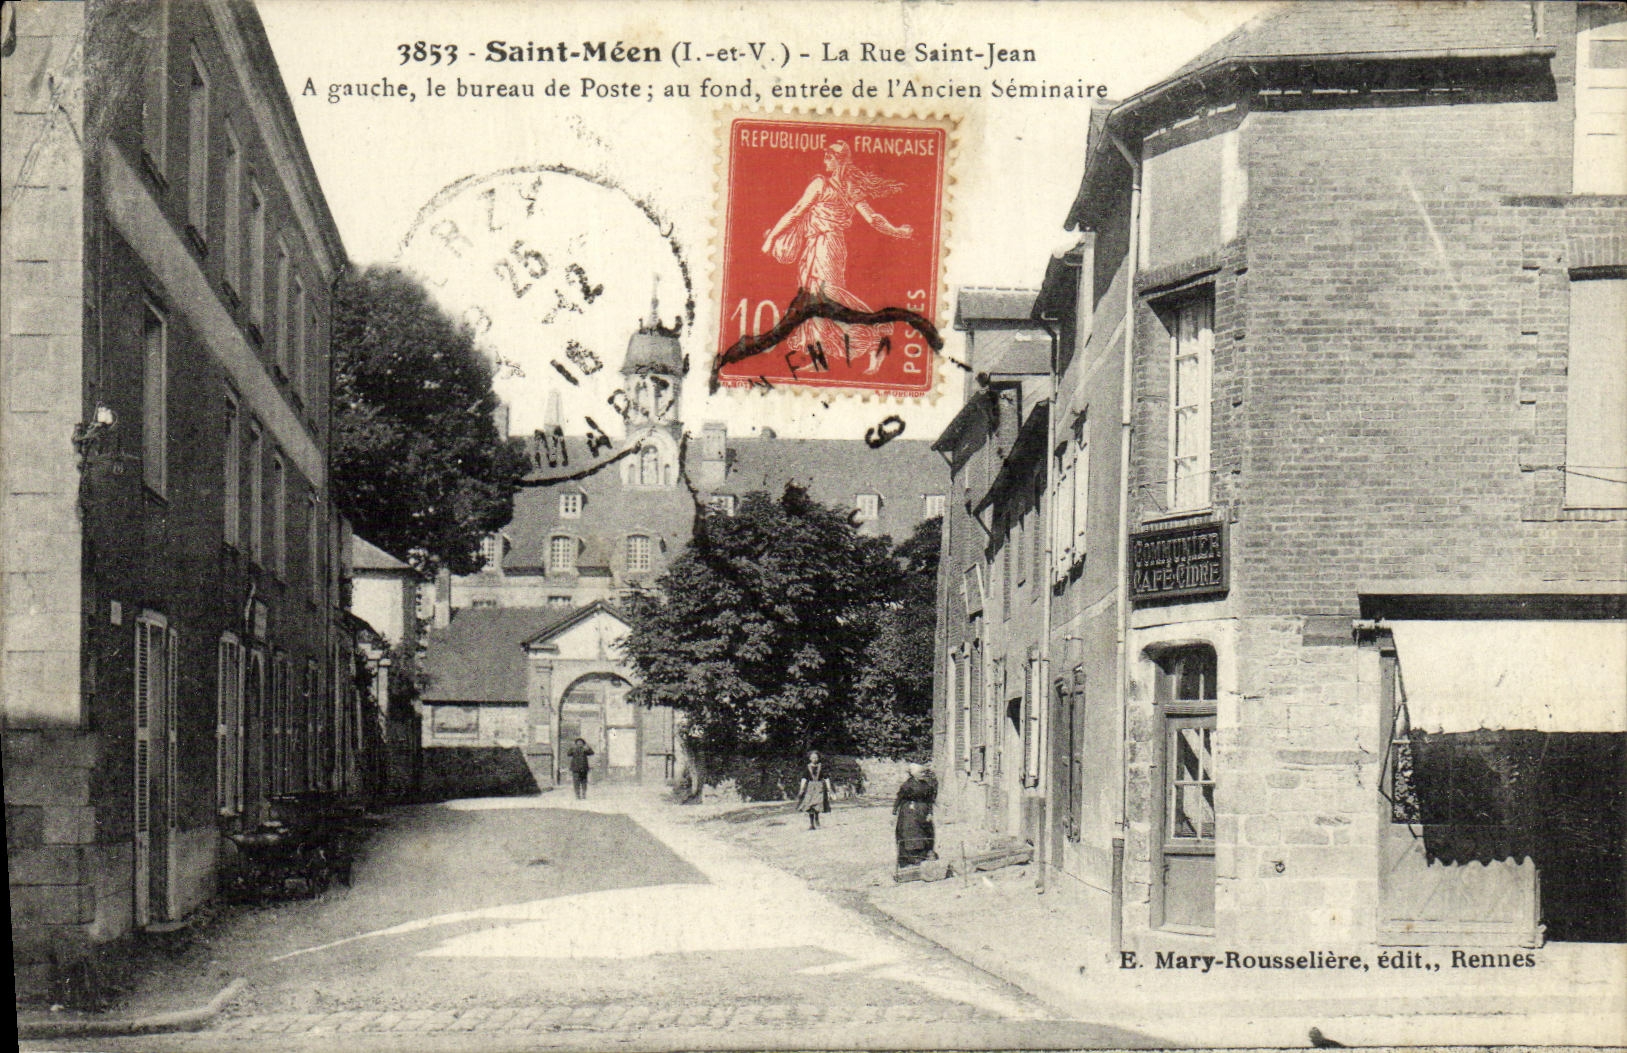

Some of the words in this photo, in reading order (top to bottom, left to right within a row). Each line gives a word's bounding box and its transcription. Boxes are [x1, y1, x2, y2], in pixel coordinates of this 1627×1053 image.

[853, 135, 935, 157] FRANÇAISE
[730, 298, 781, 354] 10
[903, 288, 927, 375] POSES
